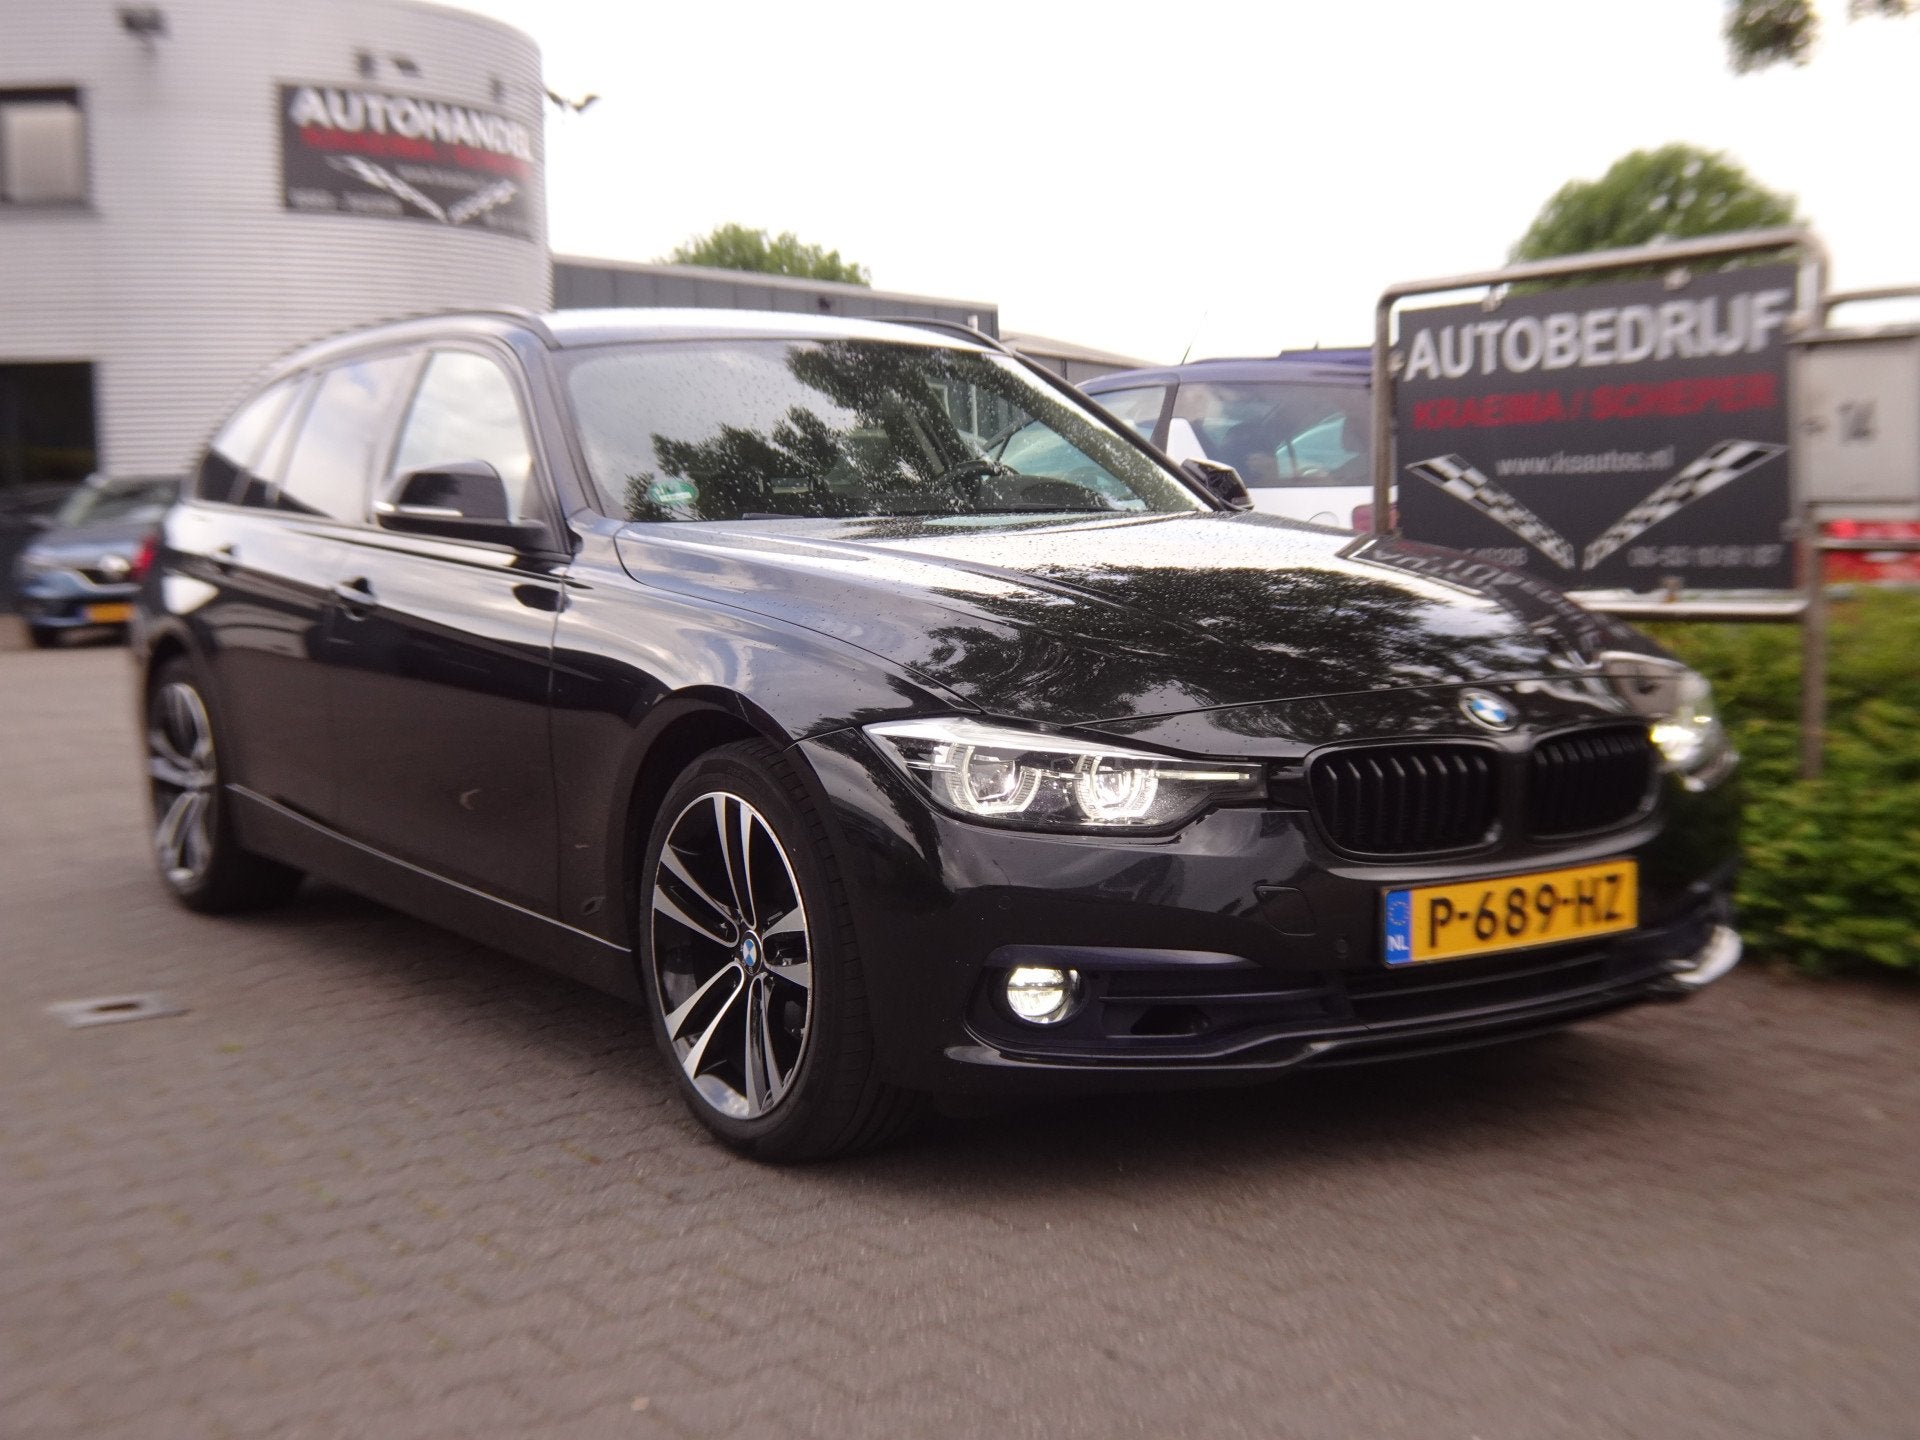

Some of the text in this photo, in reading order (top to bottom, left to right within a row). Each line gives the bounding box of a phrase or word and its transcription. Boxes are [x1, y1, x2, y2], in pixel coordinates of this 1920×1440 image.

[1403, 288, 1791, 382] AUTOBEDRIJF
[1387, 934, 1410, 951] NL
[1430, 874, 1622, 949] P-689-HZ
